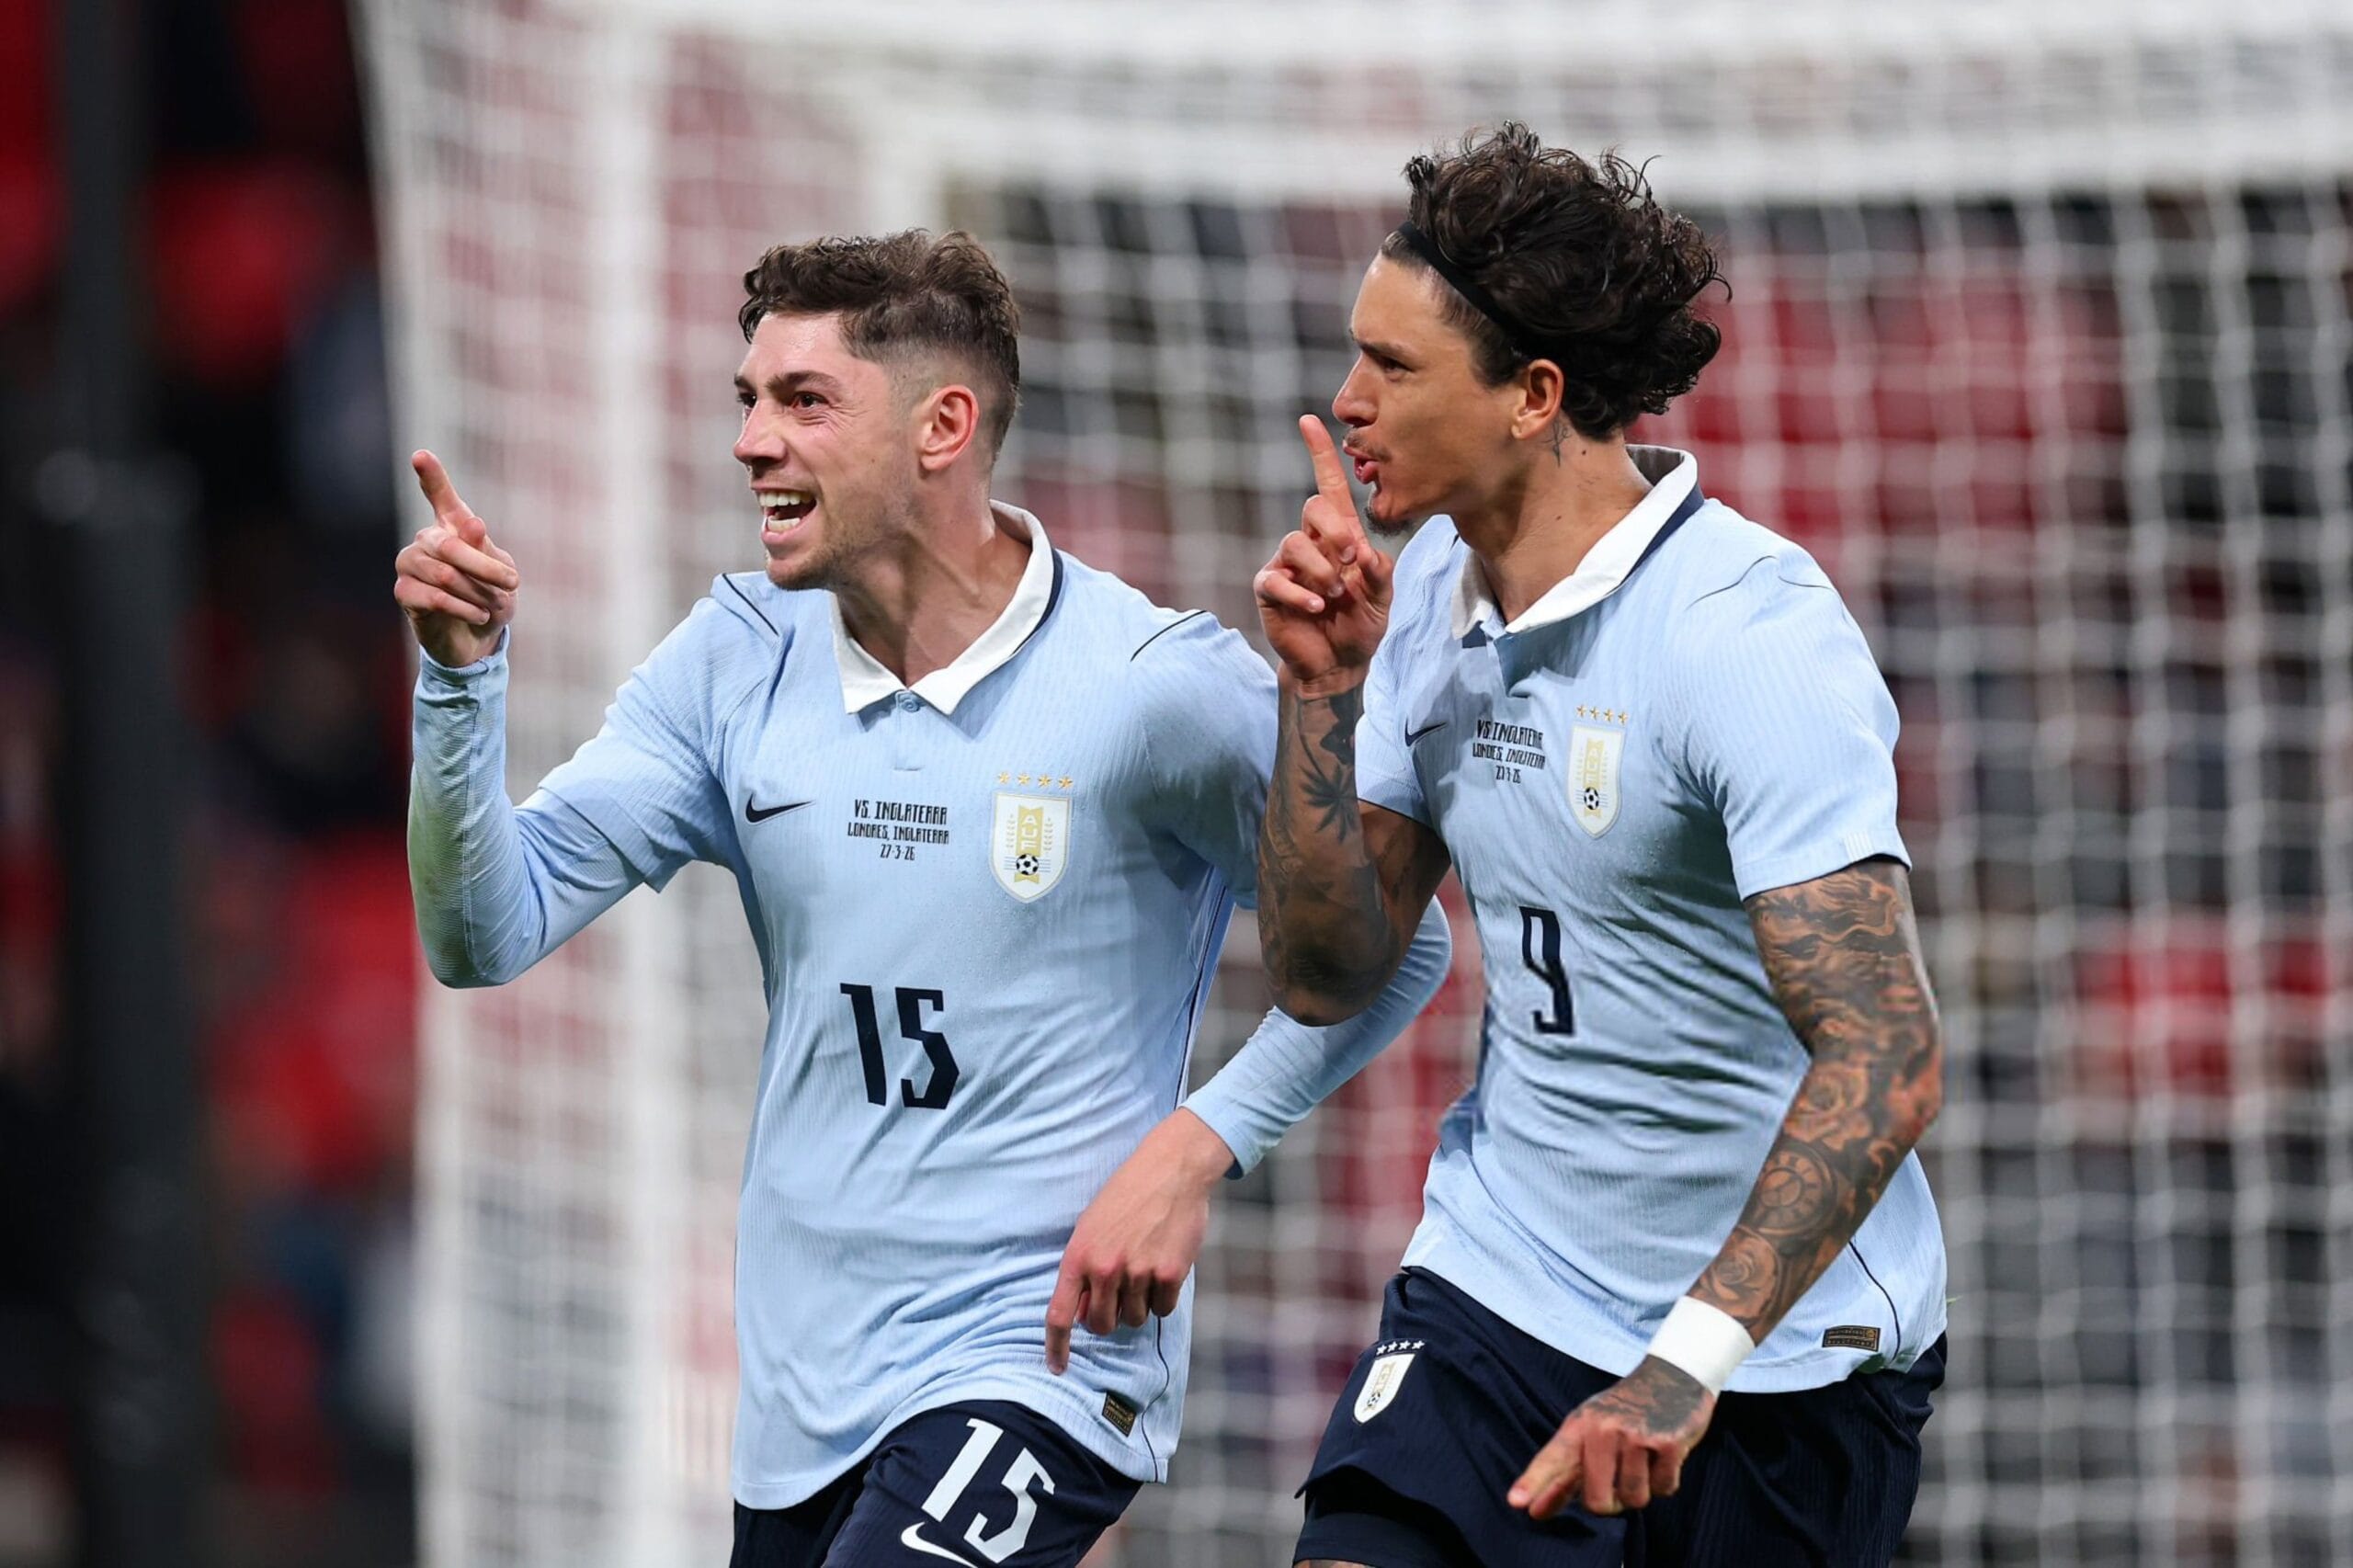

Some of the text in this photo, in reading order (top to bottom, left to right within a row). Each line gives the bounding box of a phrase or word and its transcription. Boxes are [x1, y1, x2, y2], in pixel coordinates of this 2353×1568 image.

[1477, 719, 1544, 751] VS. INGLATEA
[855, 799, 948, 825] VS. INGLATERRA
[847, 822, 949, 845] LONDRES, INGLATERRA
[1021, 814, 1039, 851] AUF
[880, 844, 915, 861] 27-3-26
[1518, 906, 1574, 1035] 9
[840, 983, 960, 1109] 15
[921, 1418, 1055, 1563] 15
